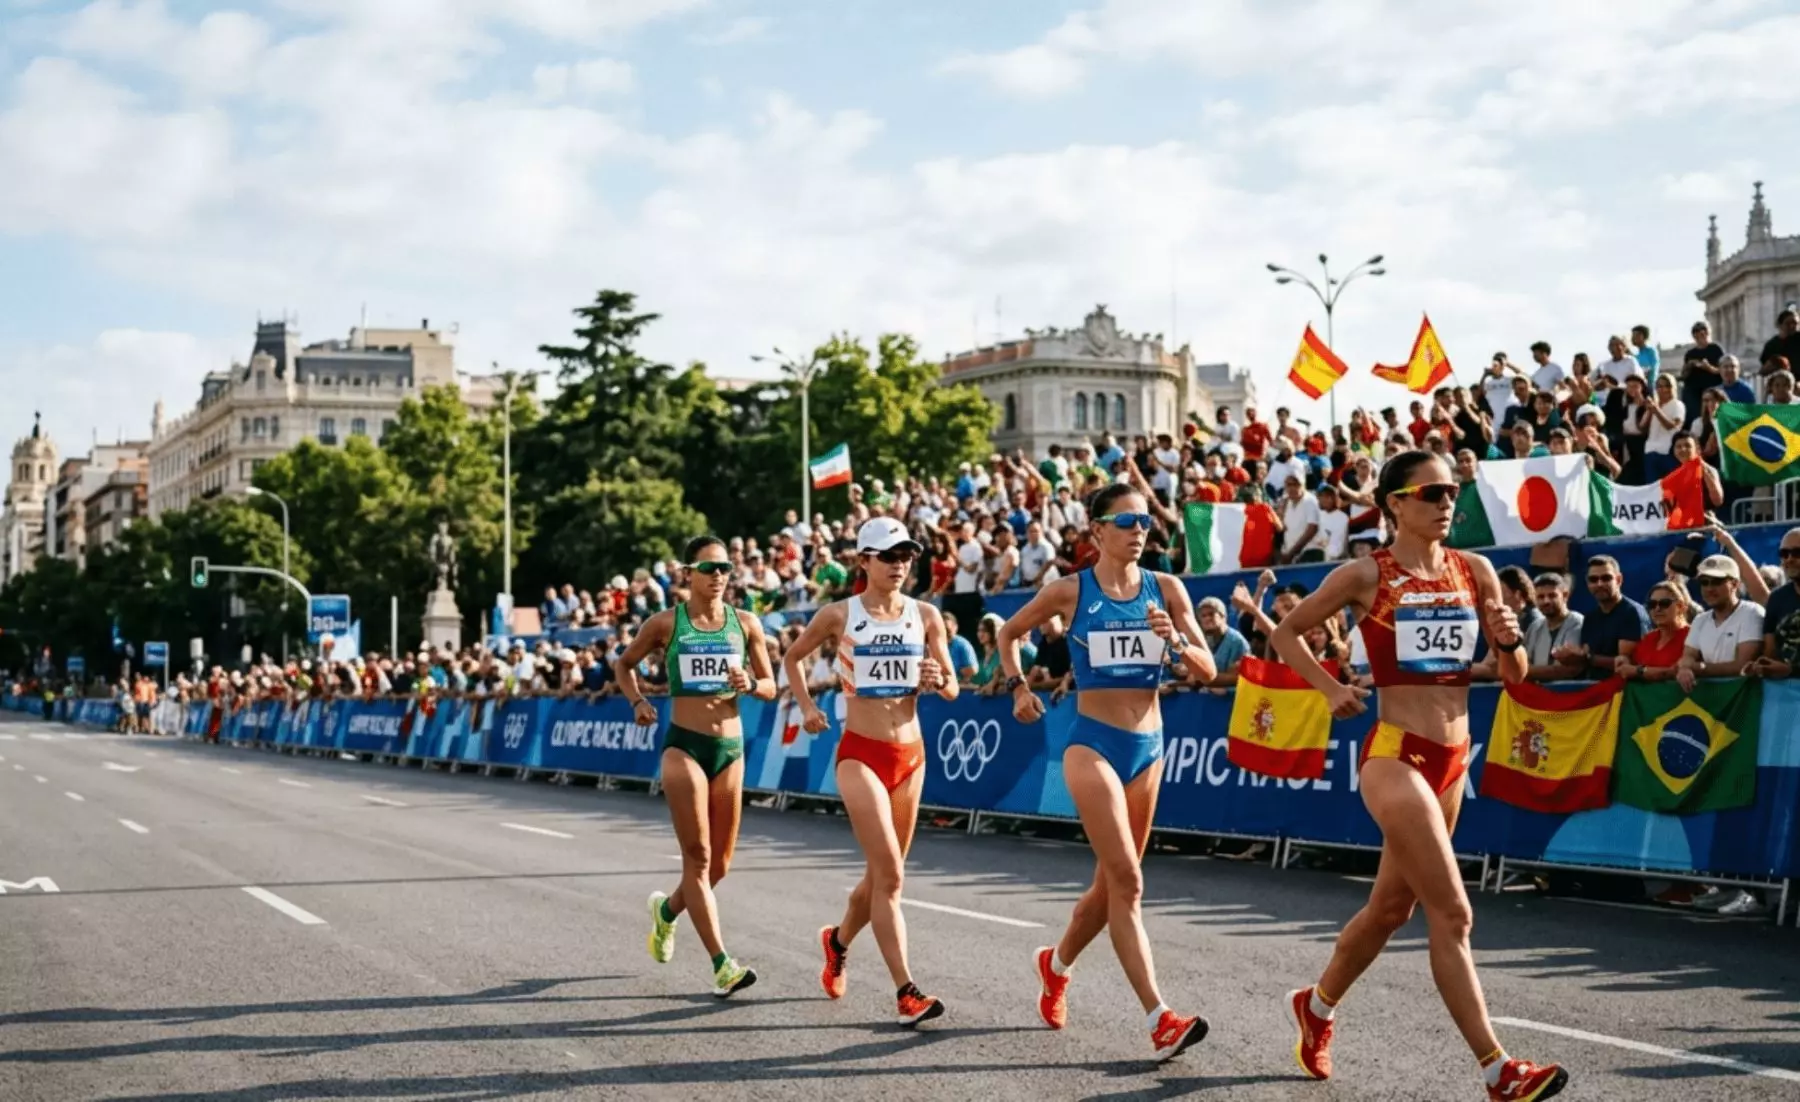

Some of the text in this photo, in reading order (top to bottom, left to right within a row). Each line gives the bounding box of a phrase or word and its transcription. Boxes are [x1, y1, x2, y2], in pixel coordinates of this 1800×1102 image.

[1110, 636, 1145, 658] ITA
[1416, 626, 1463, 652] 345
[869, 660, 908, 680] 41N
[1163, 737, 1231, 787] MPIC
